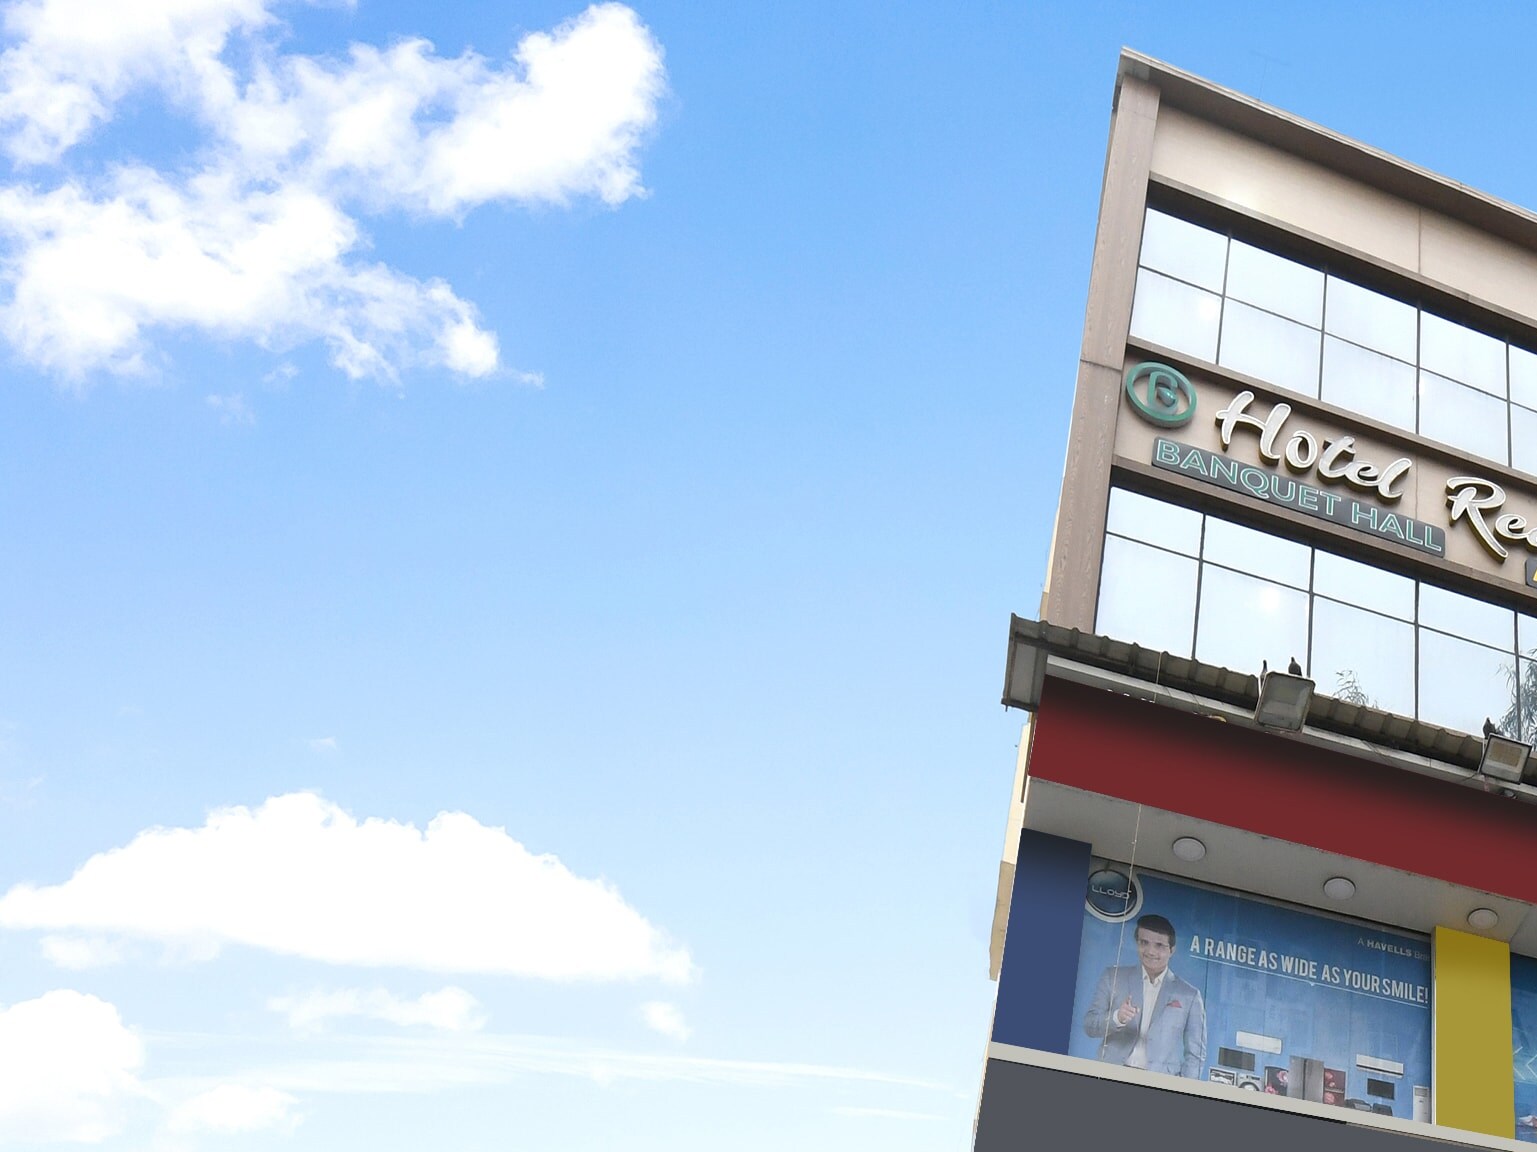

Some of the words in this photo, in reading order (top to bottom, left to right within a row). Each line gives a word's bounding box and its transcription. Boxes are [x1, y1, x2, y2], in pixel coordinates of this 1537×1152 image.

[1215, 390, 1413, 504] Hotel
[1156, 438, 1342, 516] BANQUET
[1351, 502, 1443, 552] HALL
[1092, 885, 1130, 899] LLOYD
[1189, 935, 1201, 954] A
[1204, 938, 1257, 965] RANGE
[1258, 953, 1278, 970] AS
[1281, 954, 1317, 979] WIDE
[1321, 964, 1341, 983] AS
[1343, 969, 1381, 994] YOUR
[1382, 978, 1429, 1004] SMILE!
[1366, 939, 1413, 957] HAVELLS
